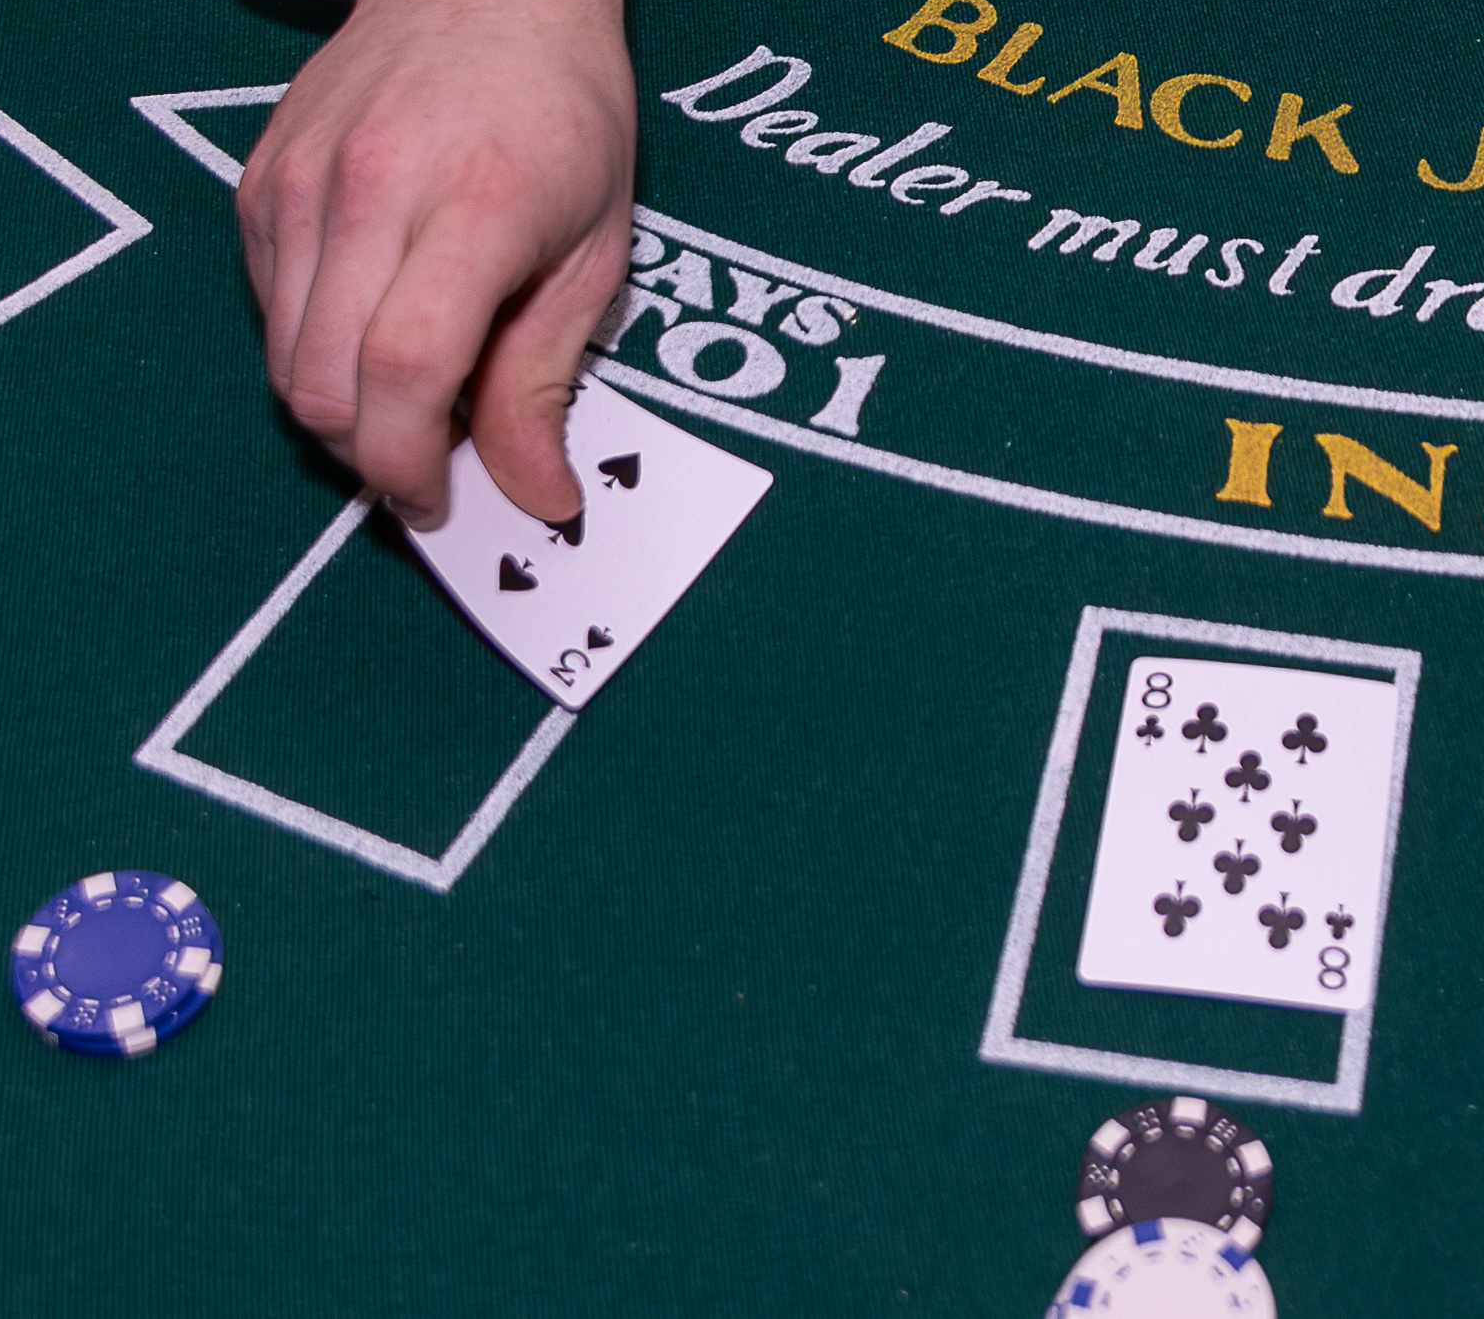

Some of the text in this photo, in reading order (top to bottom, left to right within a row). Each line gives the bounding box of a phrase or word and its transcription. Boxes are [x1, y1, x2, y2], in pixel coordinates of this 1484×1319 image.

[661, 45, 1031, 215] Dealer
[1028, 209, 1321, 295] must
[594, 282, 886, 437] TO 1
[550, 648, 590, 687] 3
[1141, 671, 1173, 709] 8
[1318, 946, 1351, 990] 8
